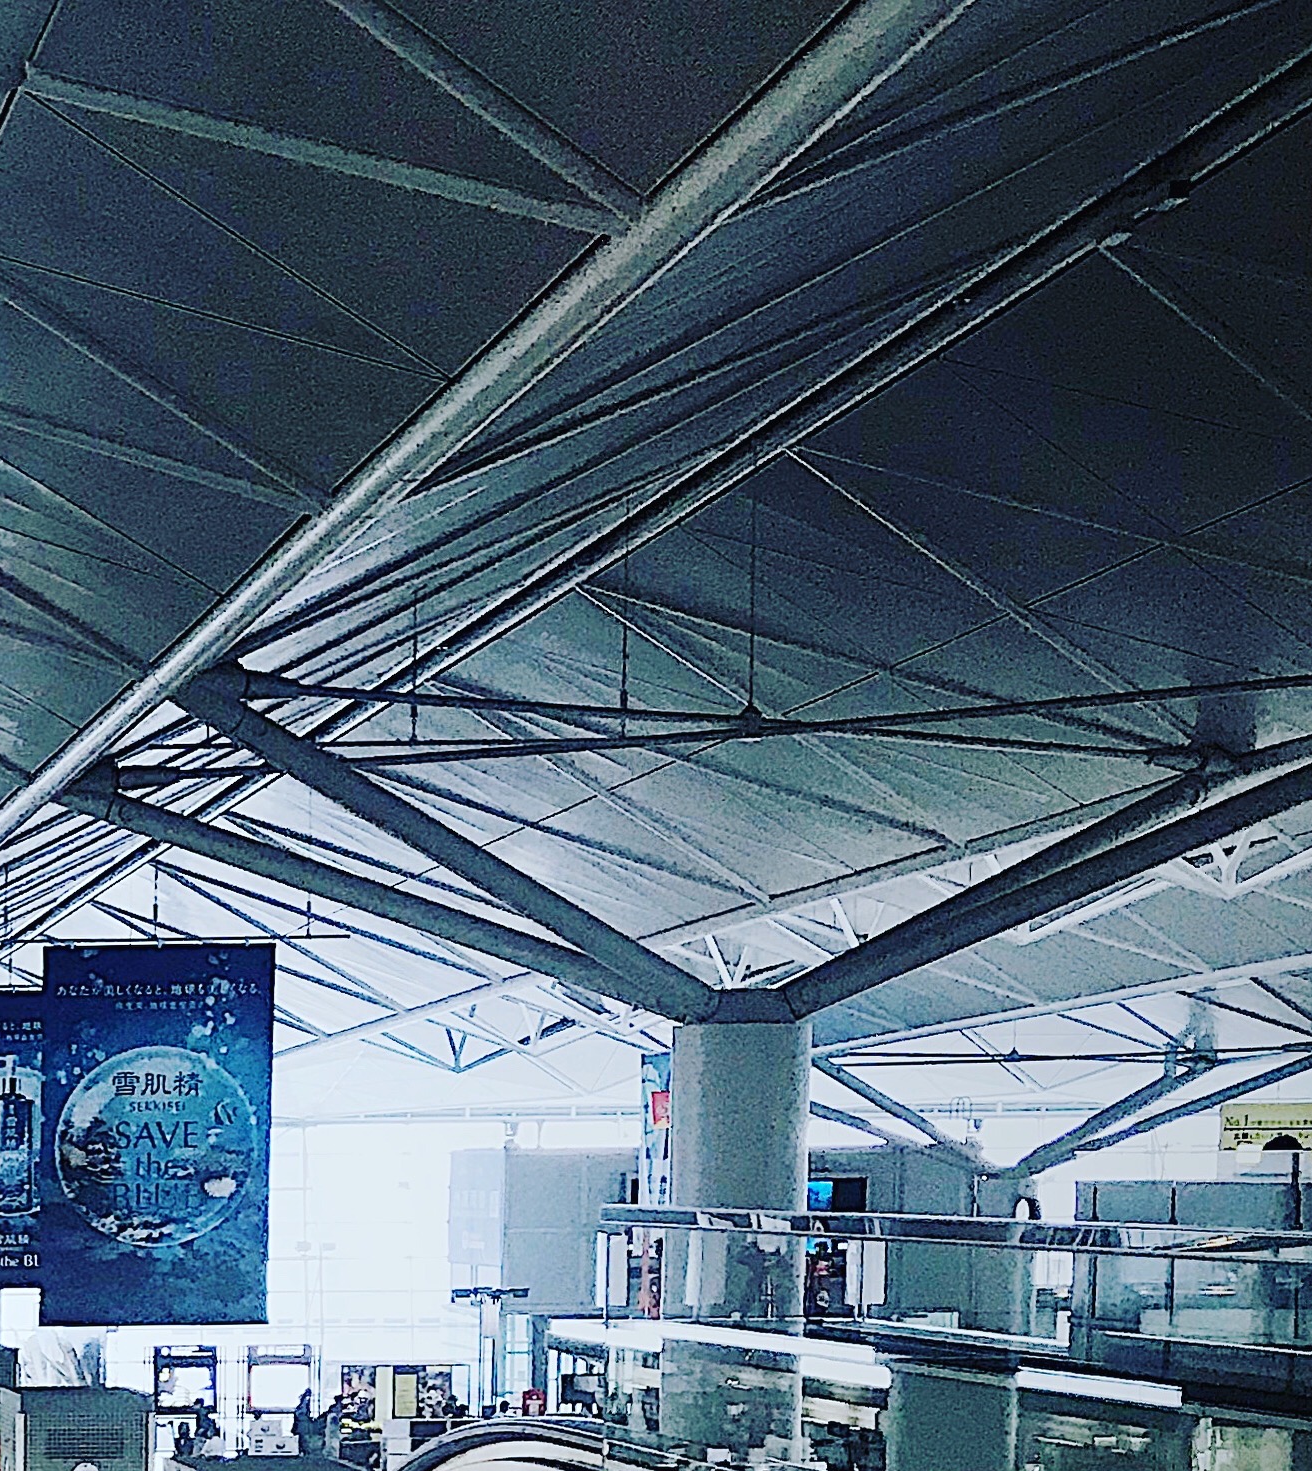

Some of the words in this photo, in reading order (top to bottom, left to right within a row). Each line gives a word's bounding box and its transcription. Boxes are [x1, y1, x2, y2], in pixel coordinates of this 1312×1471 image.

[112, 1071, 203, 1097] 雪肌精
[115, 1120, 199, 1150] SAVE
[0, 1256, 20, 1267] the
